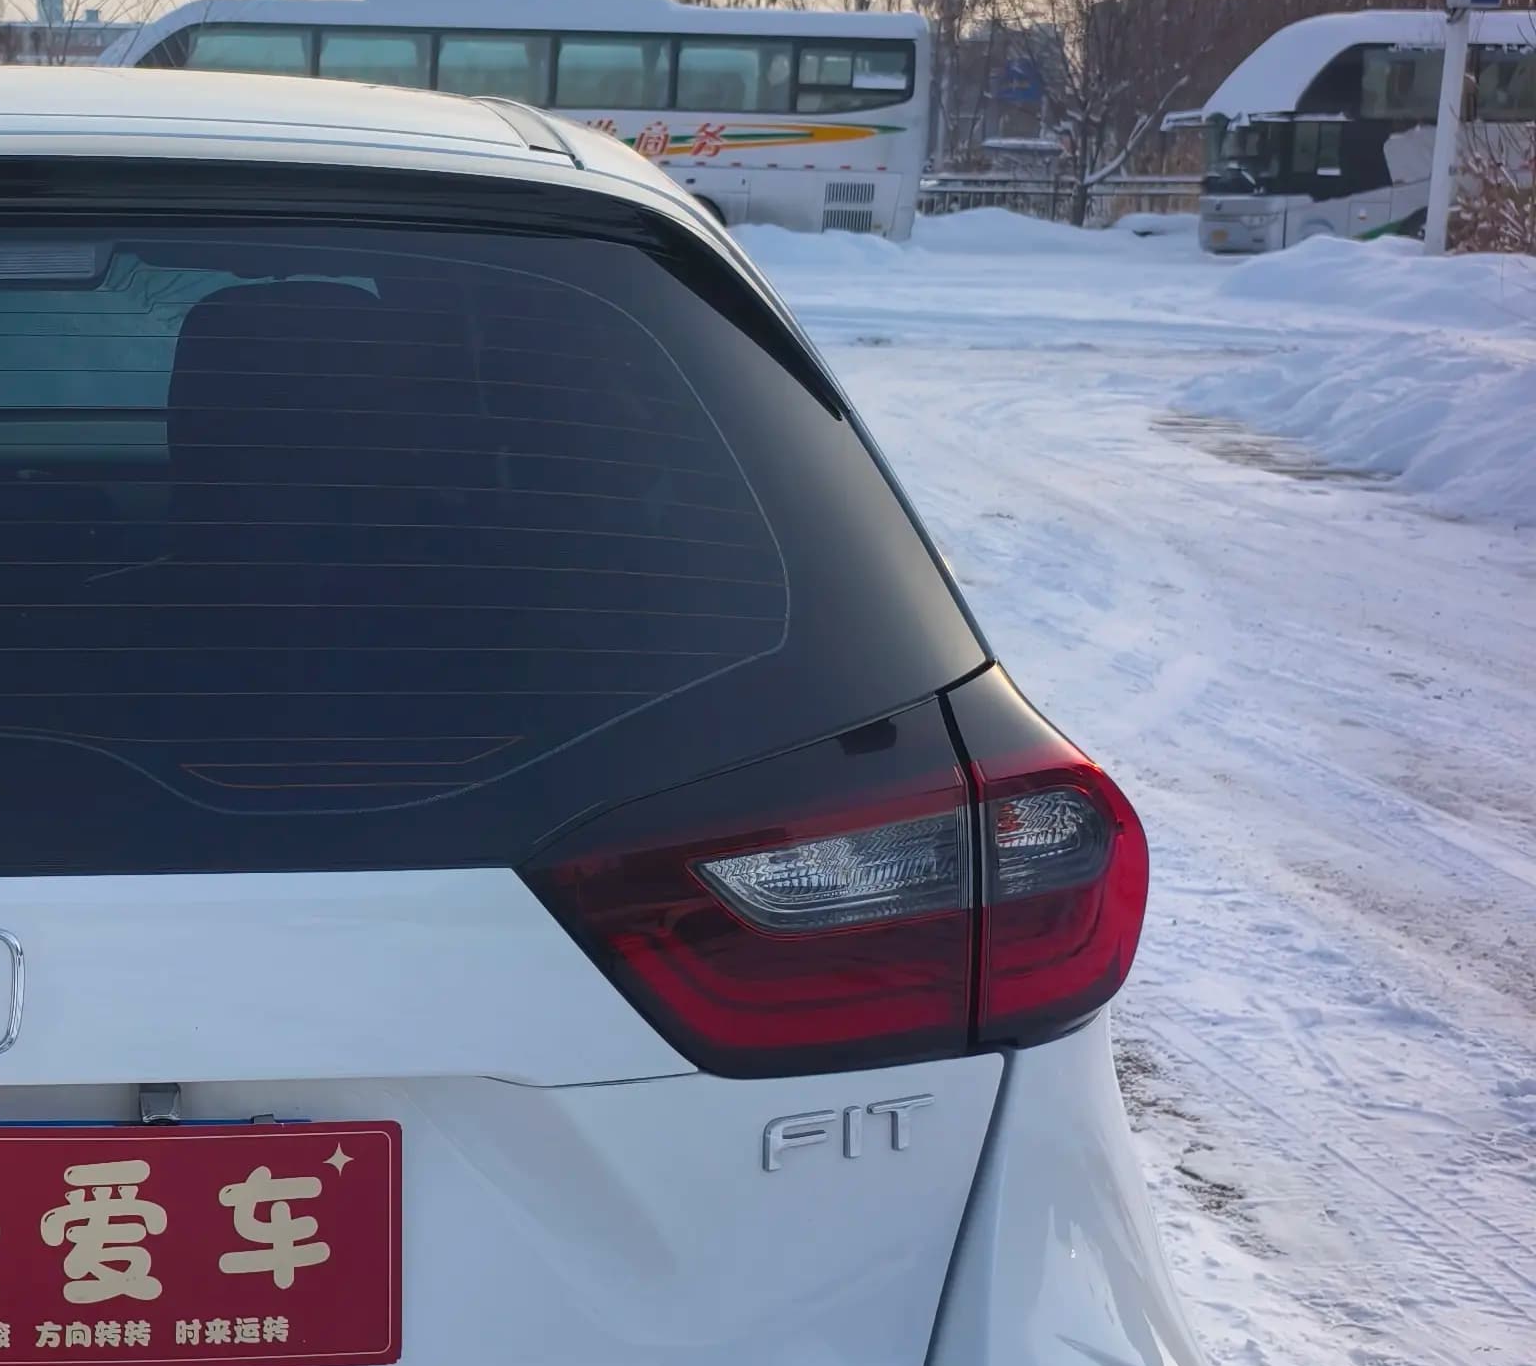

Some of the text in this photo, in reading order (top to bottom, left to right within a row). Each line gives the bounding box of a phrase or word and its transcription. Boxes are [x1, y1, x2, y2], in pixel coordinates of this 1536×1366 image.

[762, 1093, 935, 1172] FIT
[35, 1320, 152, 1348] 方向转转
[175, 1316, 289, 1345] 时来运转
